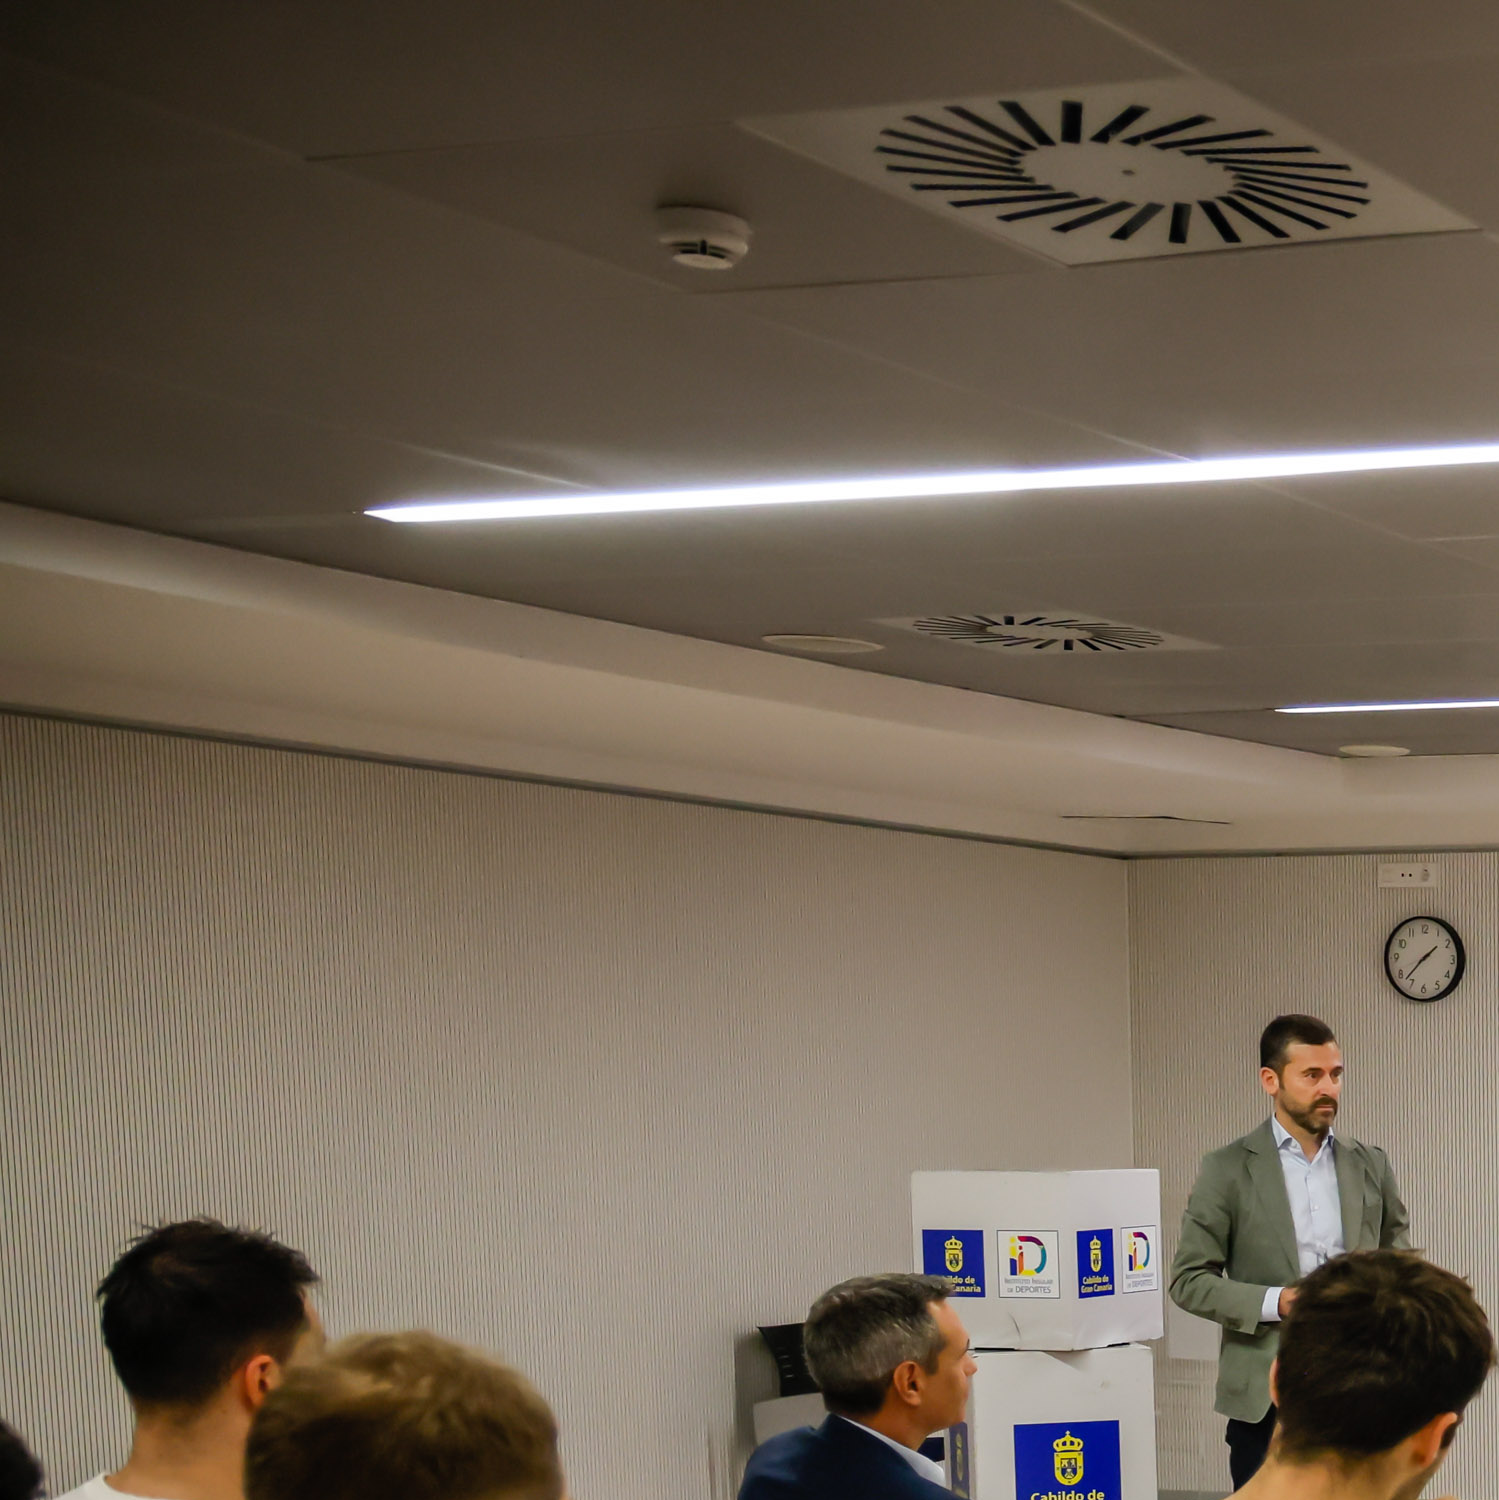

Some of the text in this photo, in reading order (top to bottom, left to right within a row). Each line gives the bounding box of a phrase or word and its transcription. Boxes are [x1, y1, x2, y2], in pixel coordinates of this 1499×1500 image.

[965, 1276, 975, 1284] de
[1015, 1286, 1051, 1294] DEPORTES
[1087, 1489, 1105, 1500] de
